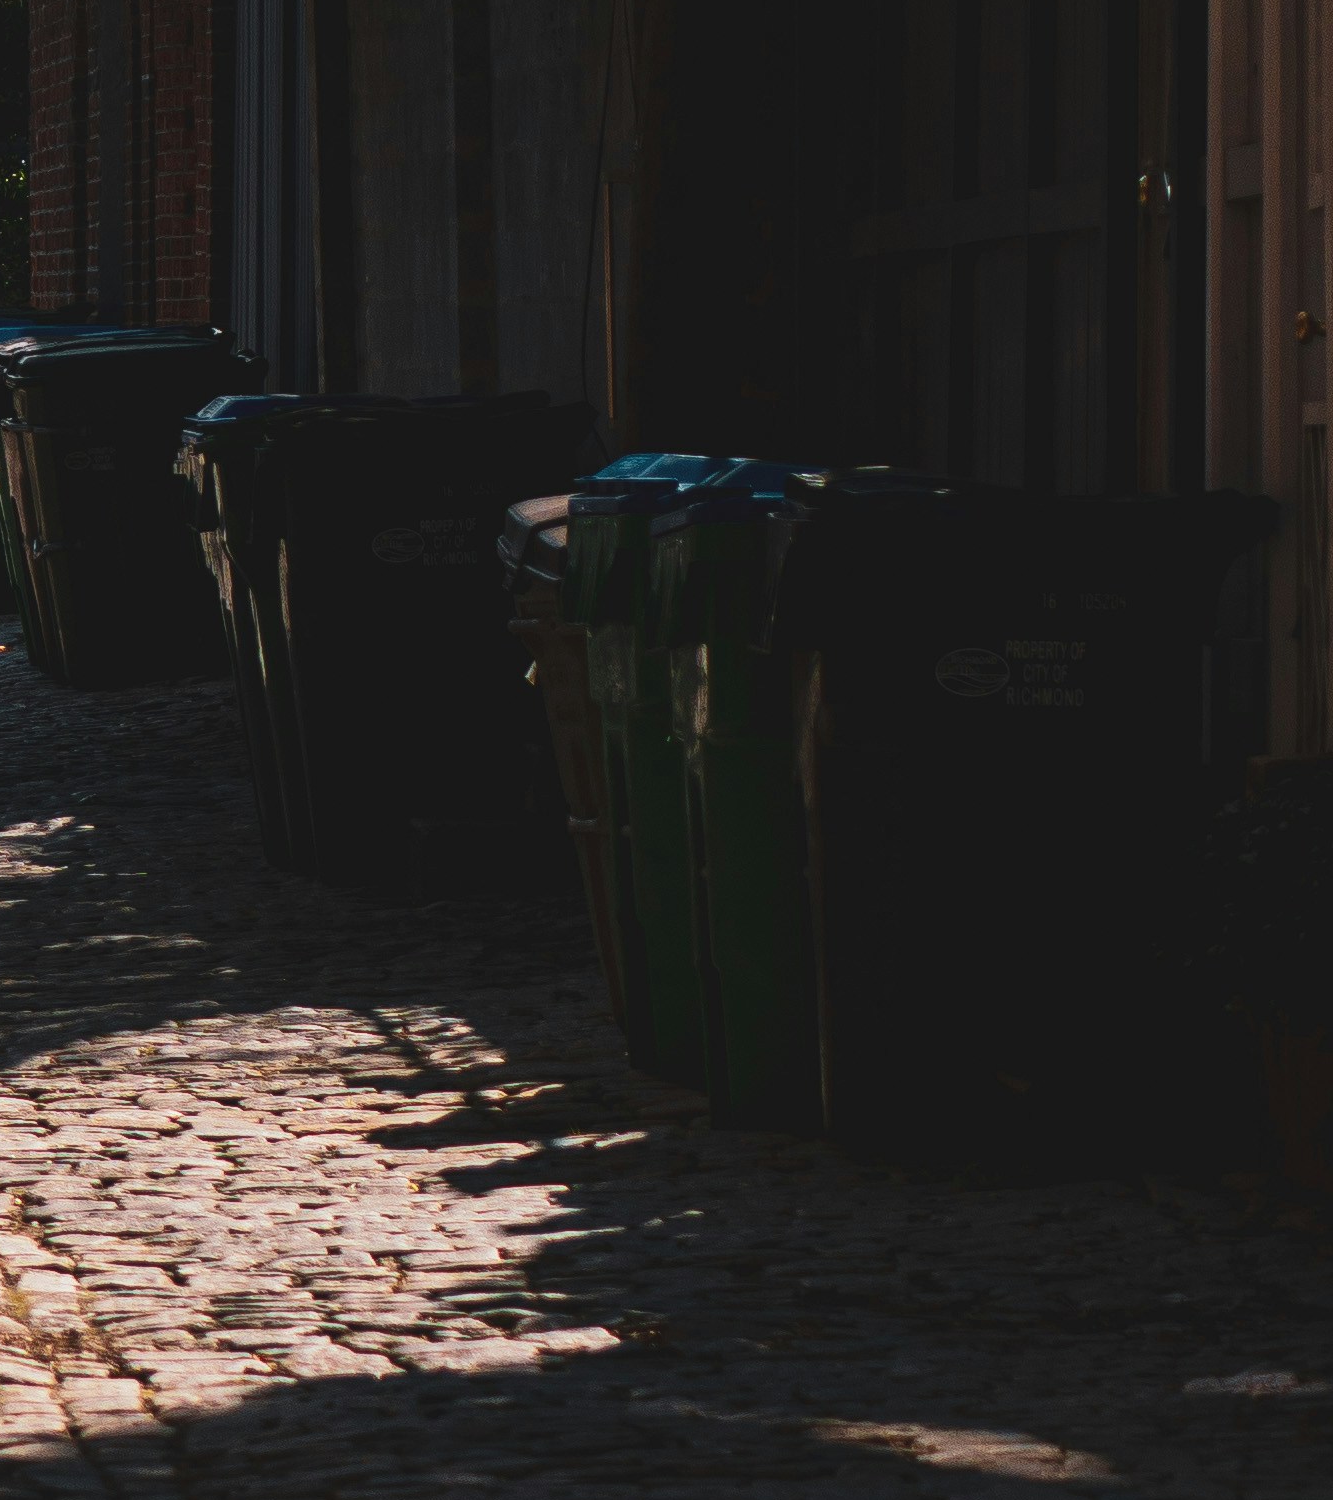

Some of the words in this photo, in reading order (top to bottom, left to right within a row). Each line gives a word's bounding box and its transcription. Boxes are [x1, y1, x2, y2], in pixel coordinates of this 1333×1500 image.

[420, 518, 463, 533] PROPERY
[465, 517, 477, 532] OF
[423, 551, 478, 566] RICHMOND
[1042, 592, 1057, 609] 16
[1005, 640, 1068, 659] PROPERTY
[1070, 642, 1087, 660] OF
[1023, 664, 1049, 683] CITY
[1052, 664, 1069, 683] OF
[1006, 686, 1084, 707] RICHMOND
